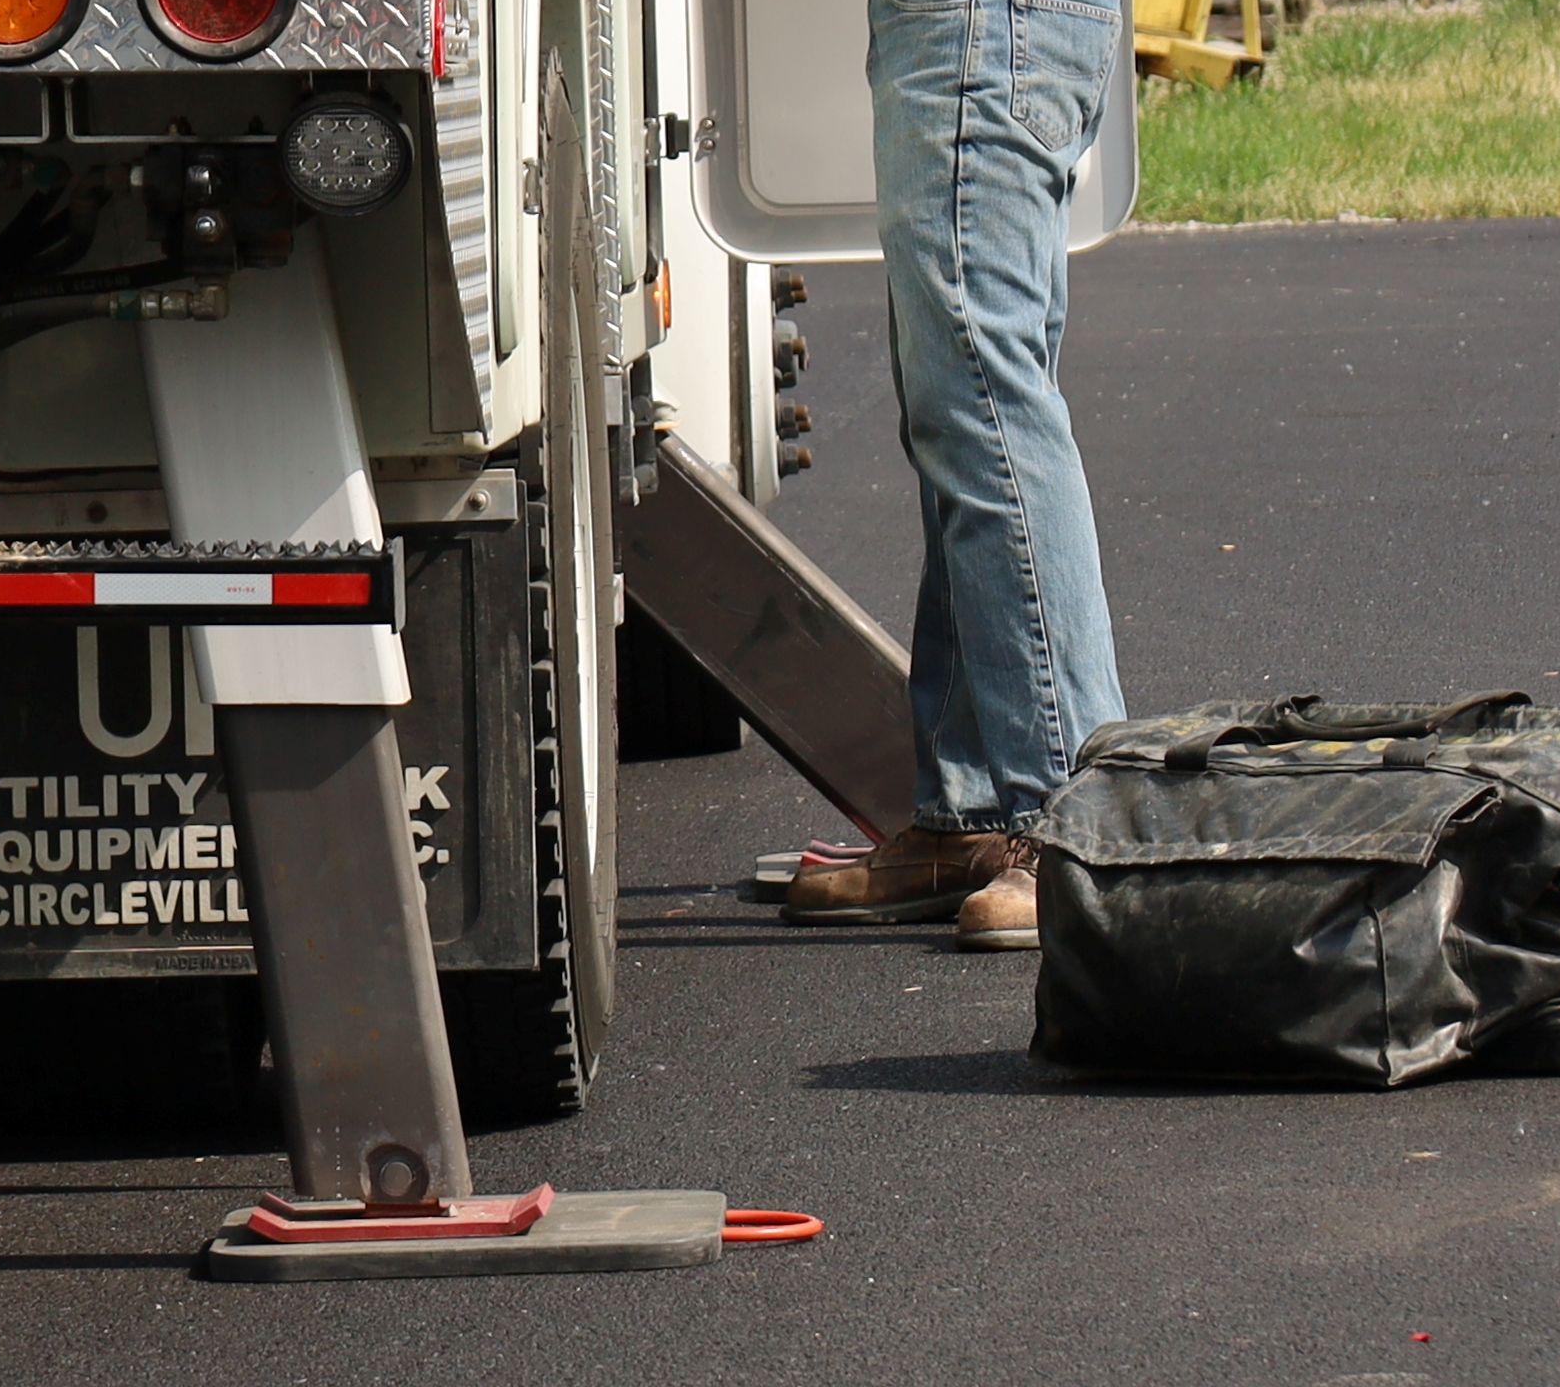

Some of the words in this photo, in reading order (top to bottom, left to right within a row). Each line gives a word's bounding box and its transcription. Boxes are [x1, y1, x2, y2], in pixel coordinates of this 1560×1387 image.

[155, 955, 200, 970] MADE
[202, 954, 220, 970] IN
[222, 954, 252, 969] USA
